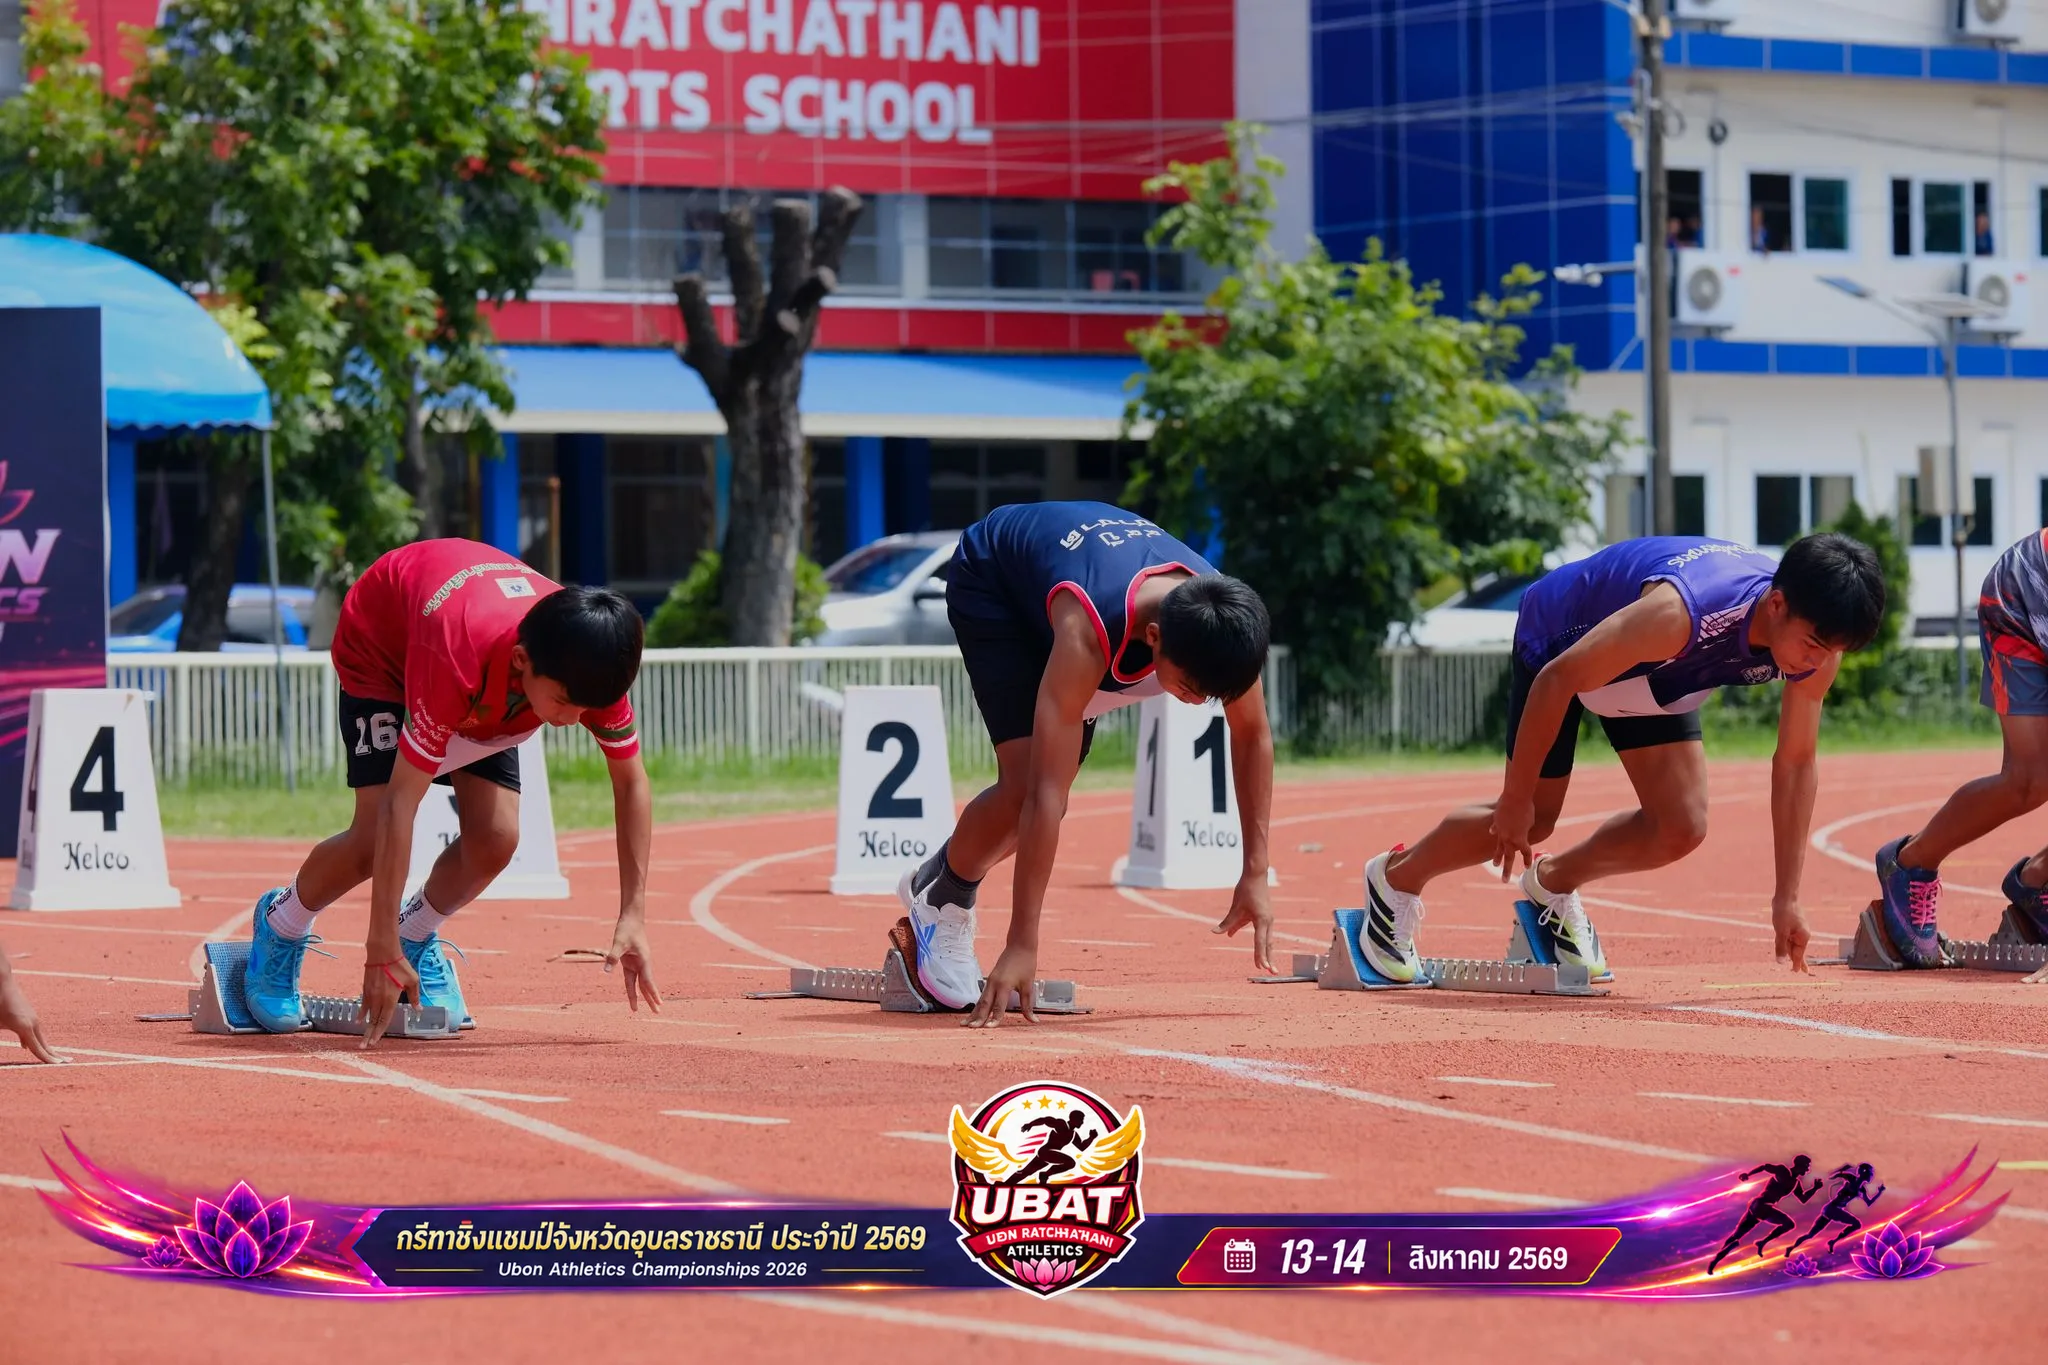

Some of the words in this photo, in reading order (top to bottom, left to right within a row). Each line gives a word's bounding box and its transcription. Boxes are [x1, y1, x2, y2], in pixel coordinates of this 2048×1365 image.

[742, 73, 993, 145] SCHOOL
[355, 712, 399, 757] 16
[70, 726, 124, 831] 4
[866, 721, 923, 818] 2
[1193, 716, 1227, 813] 1
[62, 842, 129, 870] Nelco
[859, 831, 927, 858] Nelco
[1182, 820, 1238, 847] Nelco
